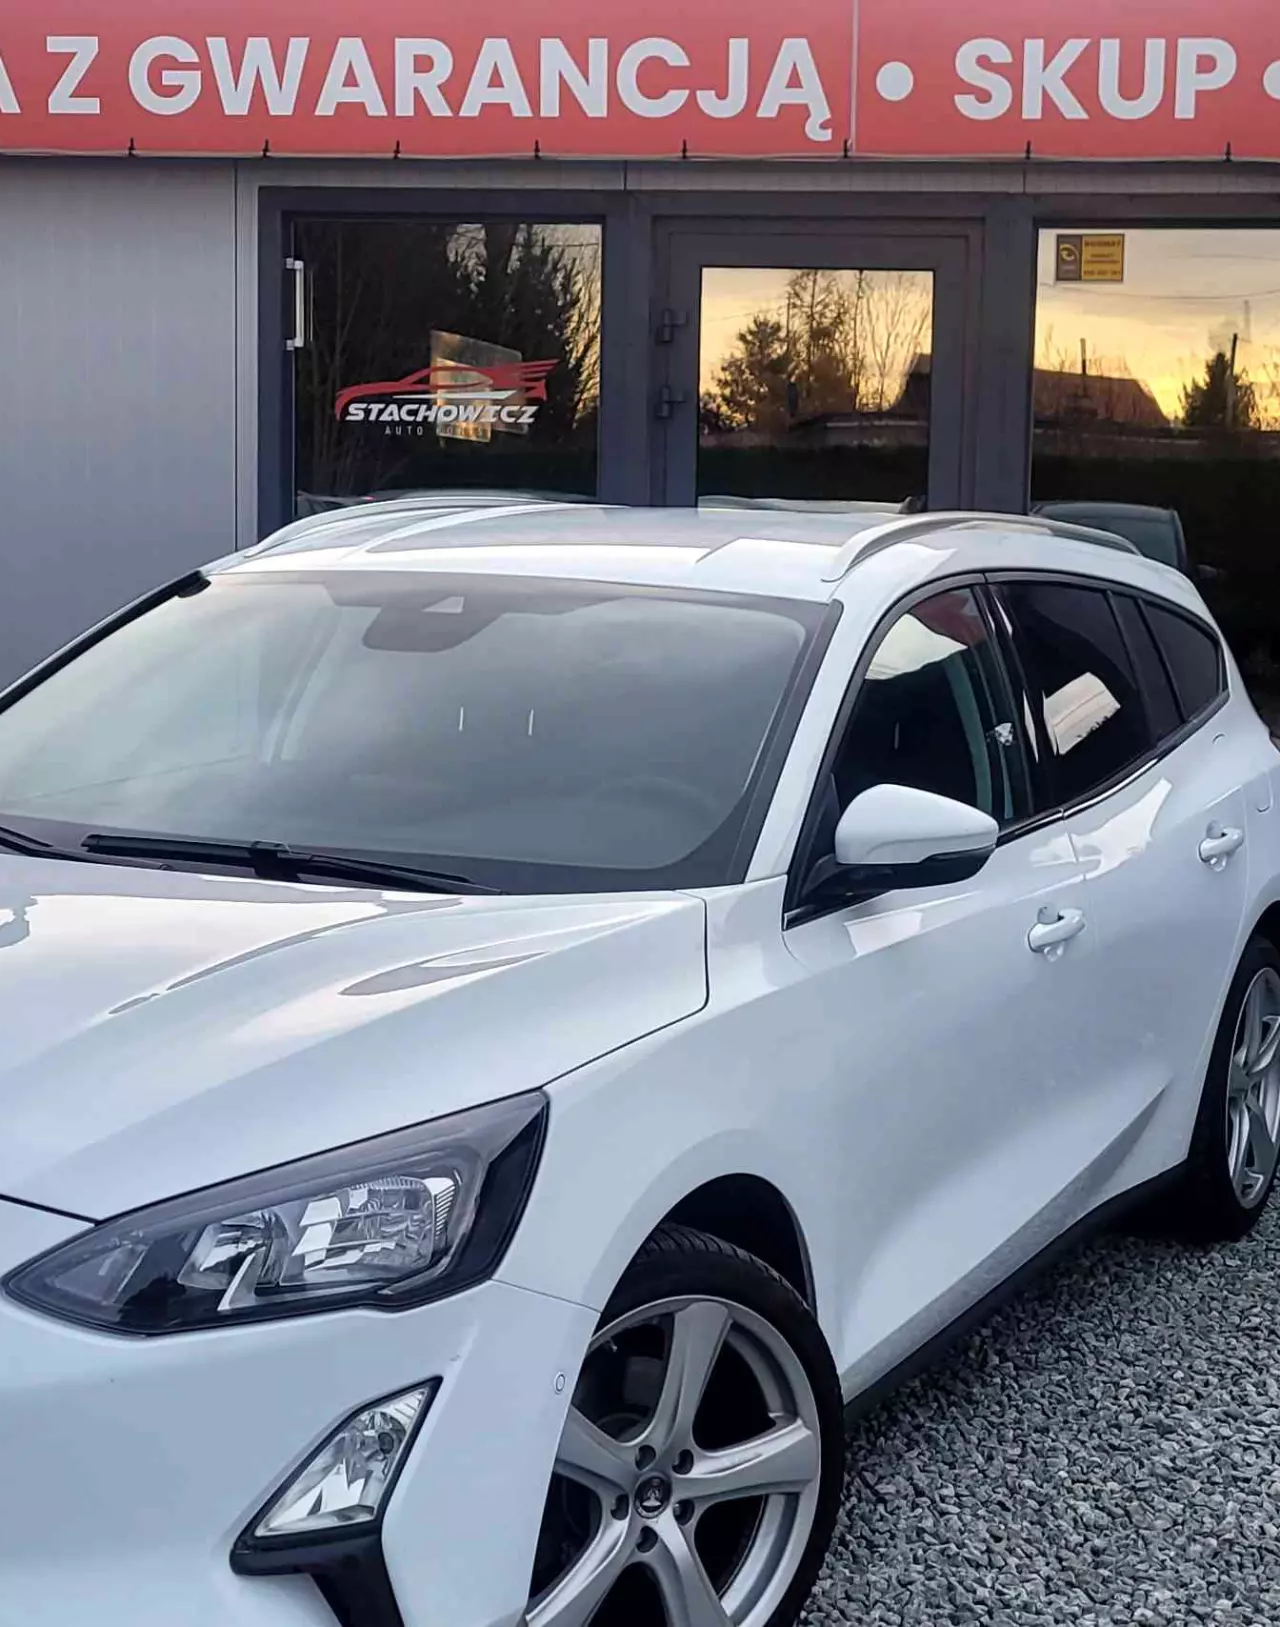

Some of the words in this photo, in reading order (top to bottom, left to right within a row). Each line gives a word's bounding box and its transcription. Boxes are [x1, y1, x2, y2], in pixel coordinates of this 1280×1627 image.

[46, 36, 100, 115] Z
[128, 36, 832, 142] GWARANCJĄ
[953, 37, 1238, 120] SKUP
[345, 402, 539, 424] STACHOWICZ
